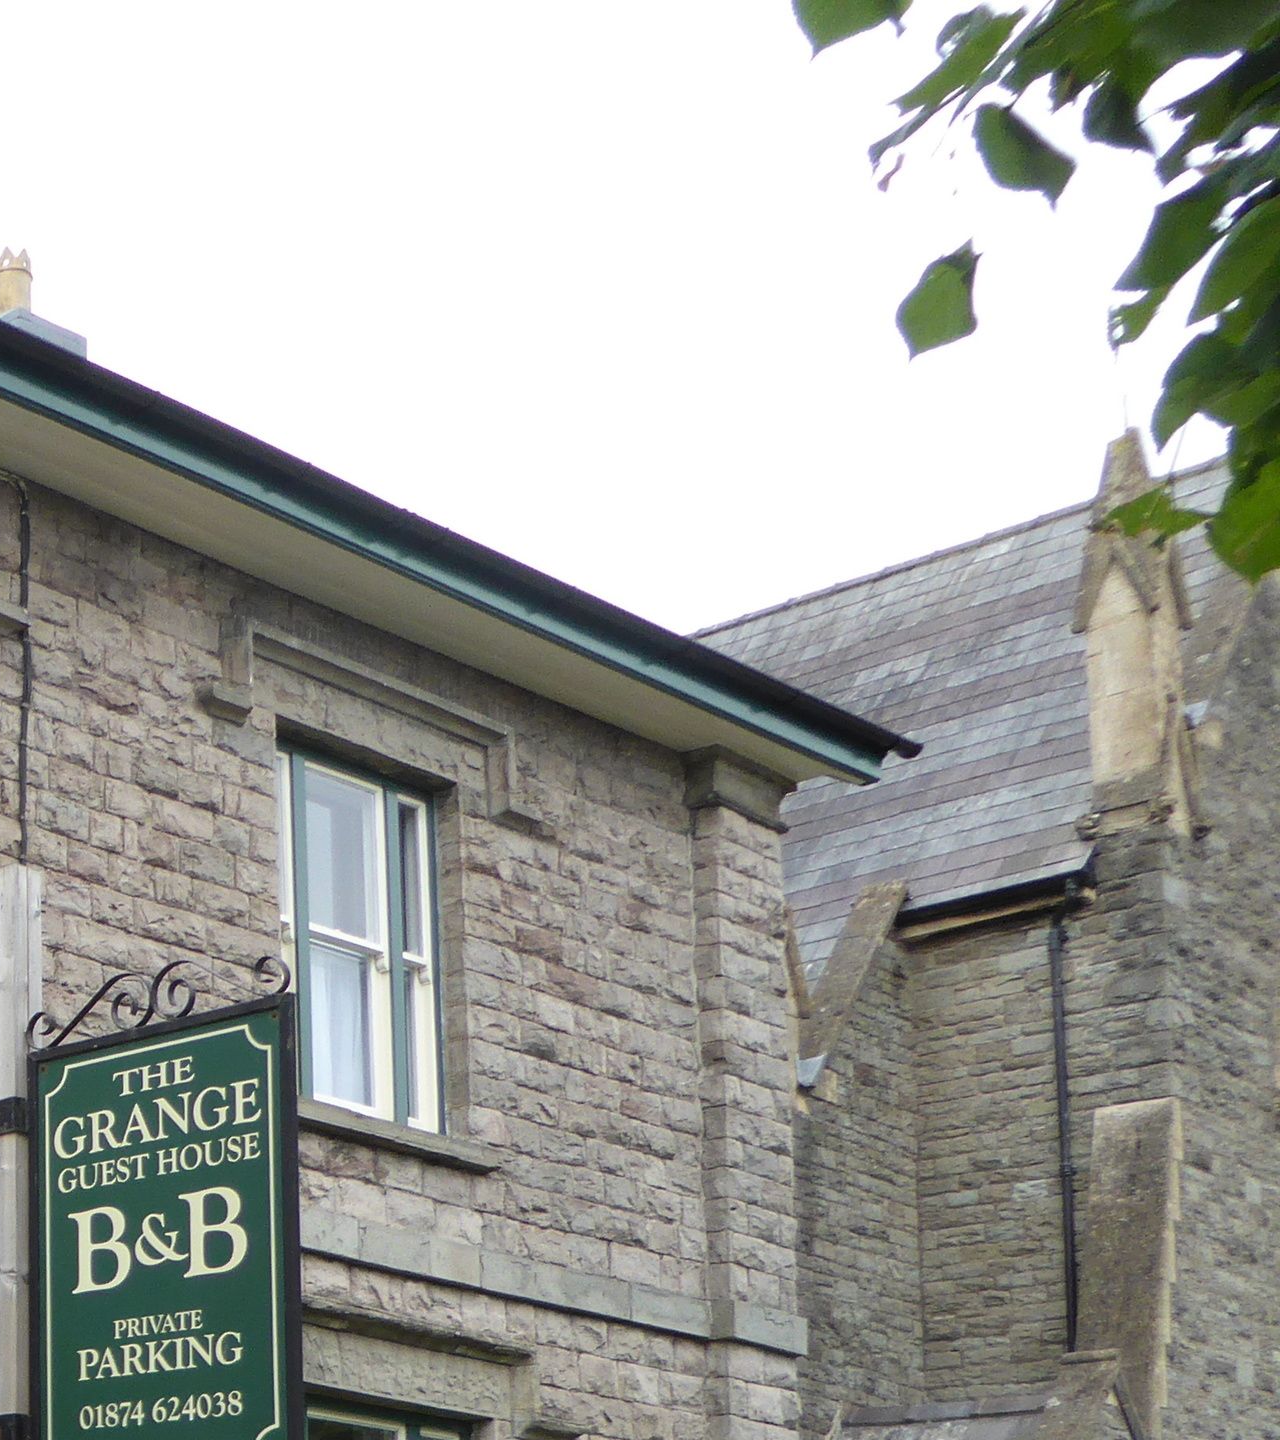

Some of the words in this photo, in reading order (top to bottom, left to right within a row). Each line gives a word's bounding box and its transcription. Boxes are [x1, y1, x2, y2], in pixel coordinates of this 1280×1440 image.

[112, 1056, 195, 1097] THE
[53, 1078, 262, 1160] GRANGE
[57, 1153, 150, 1194] GUEST
[155, 1132, 261, 1176] HOUSE
[68, 1186, 248, 1295] B&B
[113, 1309, 204, 1340] PRIVATE
[77, 1332, 244, 1382] PARKING
[79, 1402, 146, 1430] 01874
[151, 1390, 244, 1423] 624038
